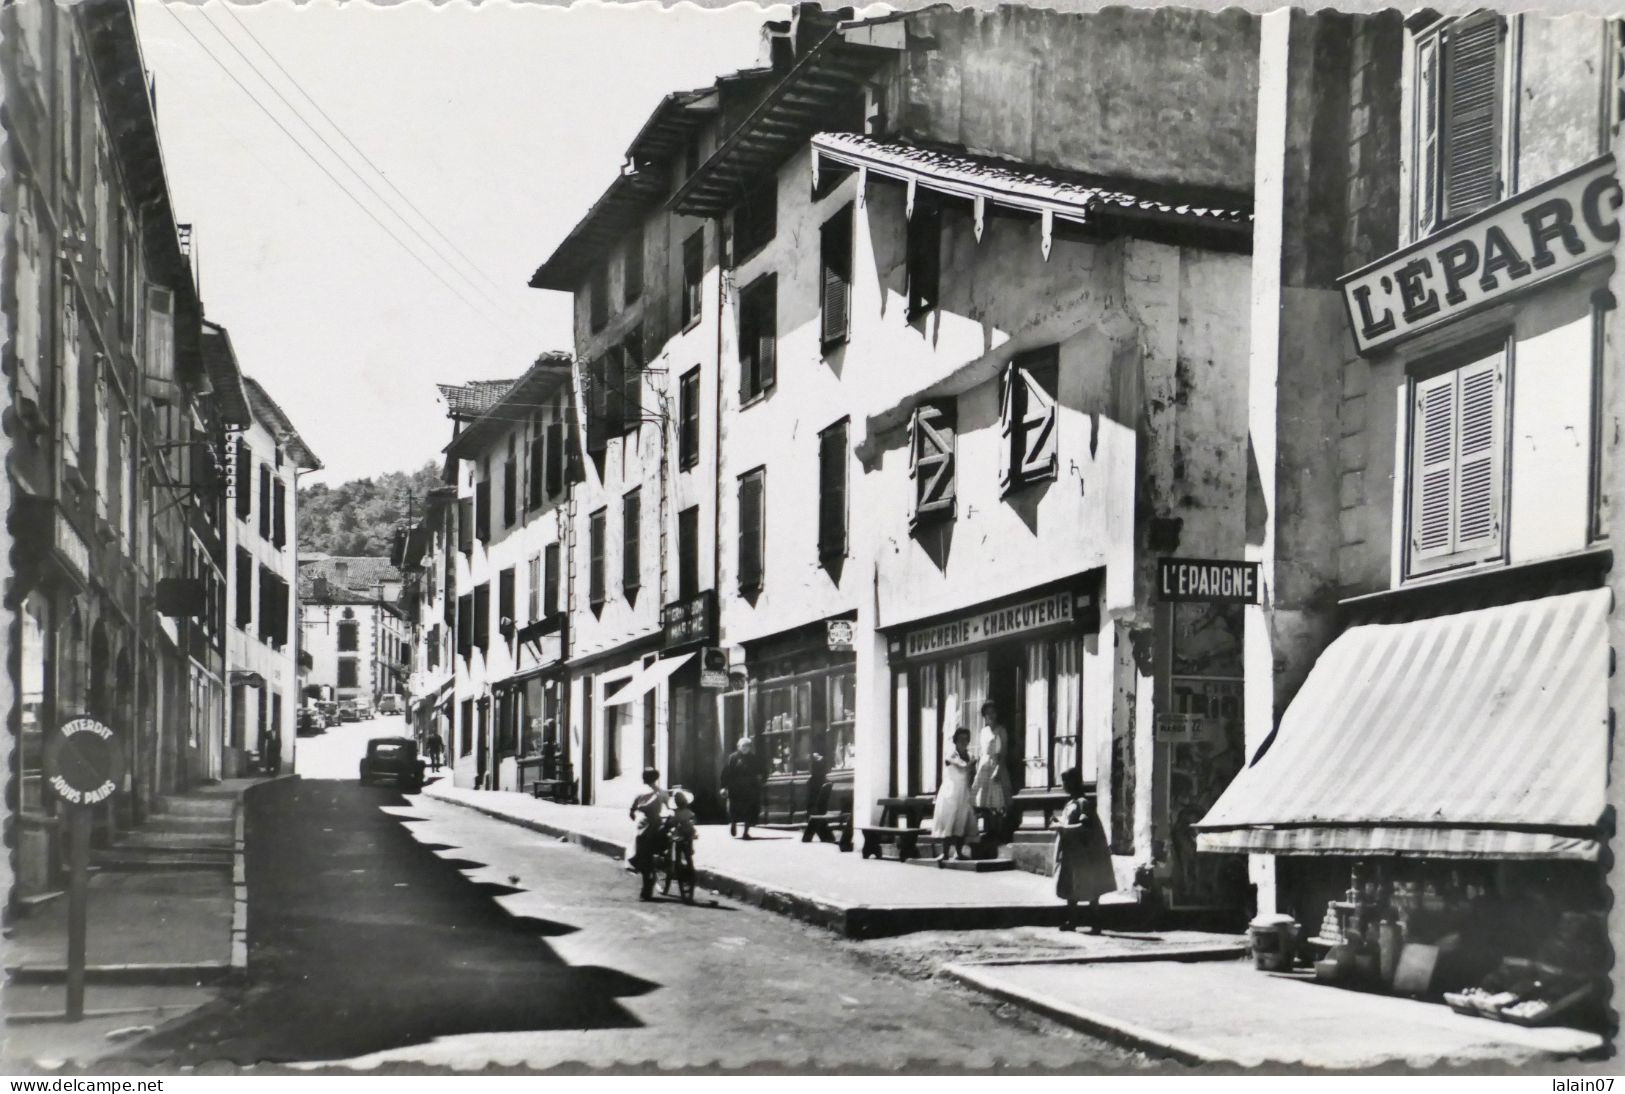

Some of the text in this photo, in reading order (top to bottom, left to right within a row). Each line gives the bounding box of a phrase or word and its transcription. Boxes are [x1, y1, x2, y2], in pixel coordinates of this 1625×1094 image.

[1163, 564, 1253, 597] L'EPARGNE
[910, 621, 970, 653] BOUCHERIE
[983, 595, 1069, 637] CHARCUTERIE
[61, 718, 114, 740] INTERDIT
[49, 775, 116, 805] JOURS PAIRS
